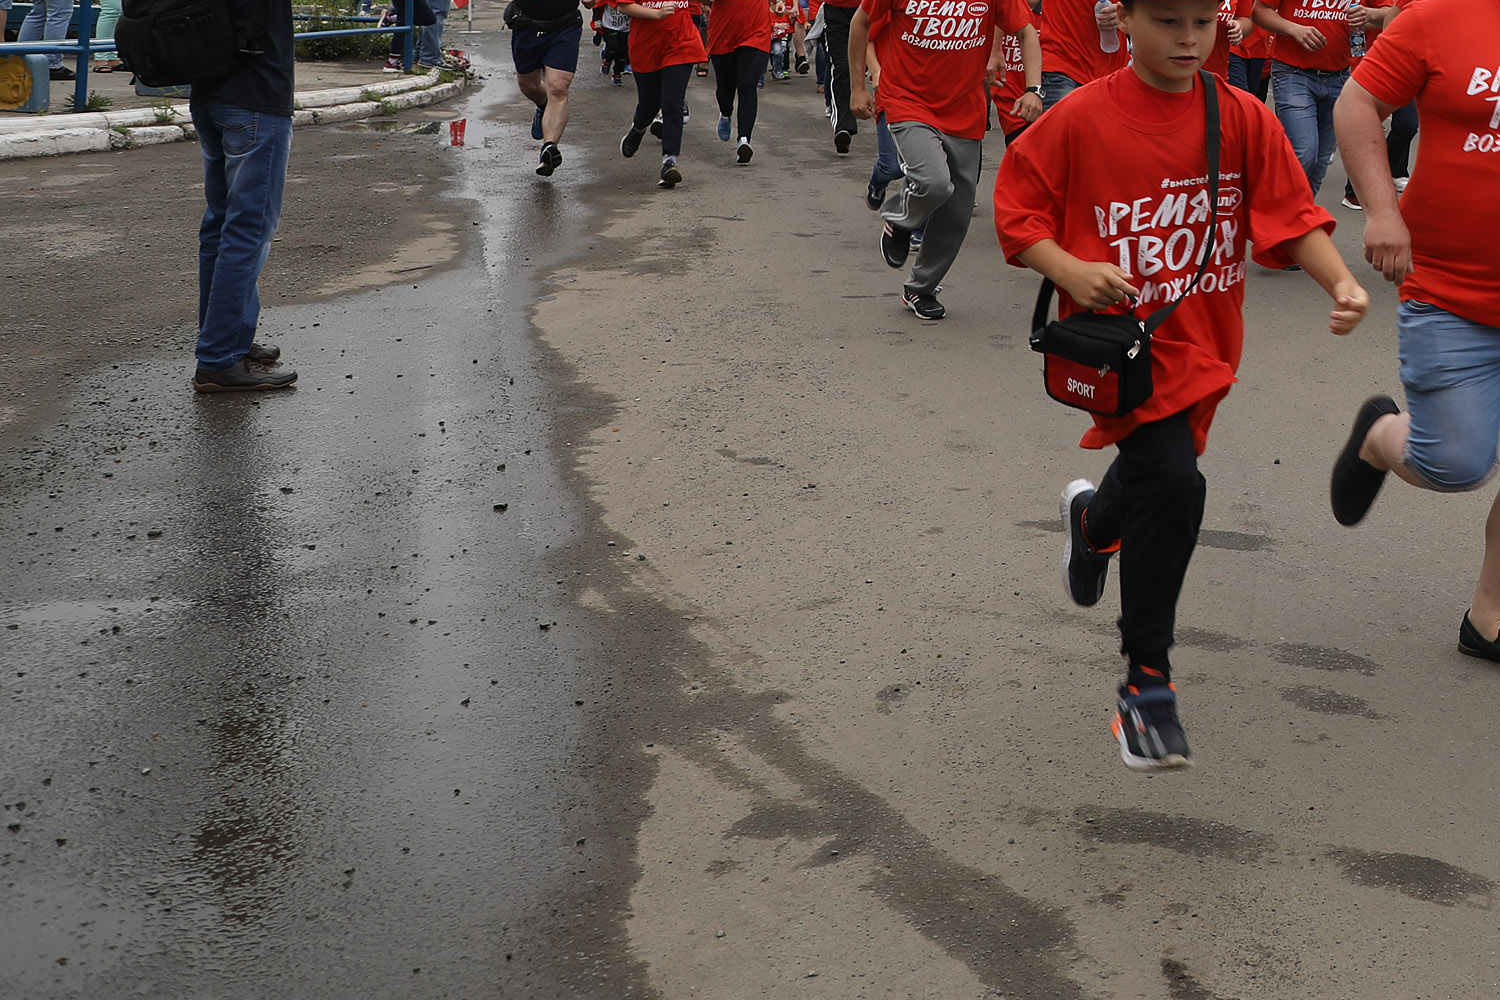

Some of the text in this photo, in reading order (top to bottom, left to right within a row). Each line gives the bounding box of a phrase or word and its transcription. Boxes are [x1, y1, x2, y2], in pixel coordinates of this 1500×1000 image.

[905, 0, 966, 17] ВРЕМЯ
[912, 17, 983, 38] ТВОИХ
[901, 31, 986, 51] ВОЗМОЖНОСТЕЙ
[1094, 188, 1209, 239] ВРЕМЯ
[1067, 377, 1095, 399] SPORT
